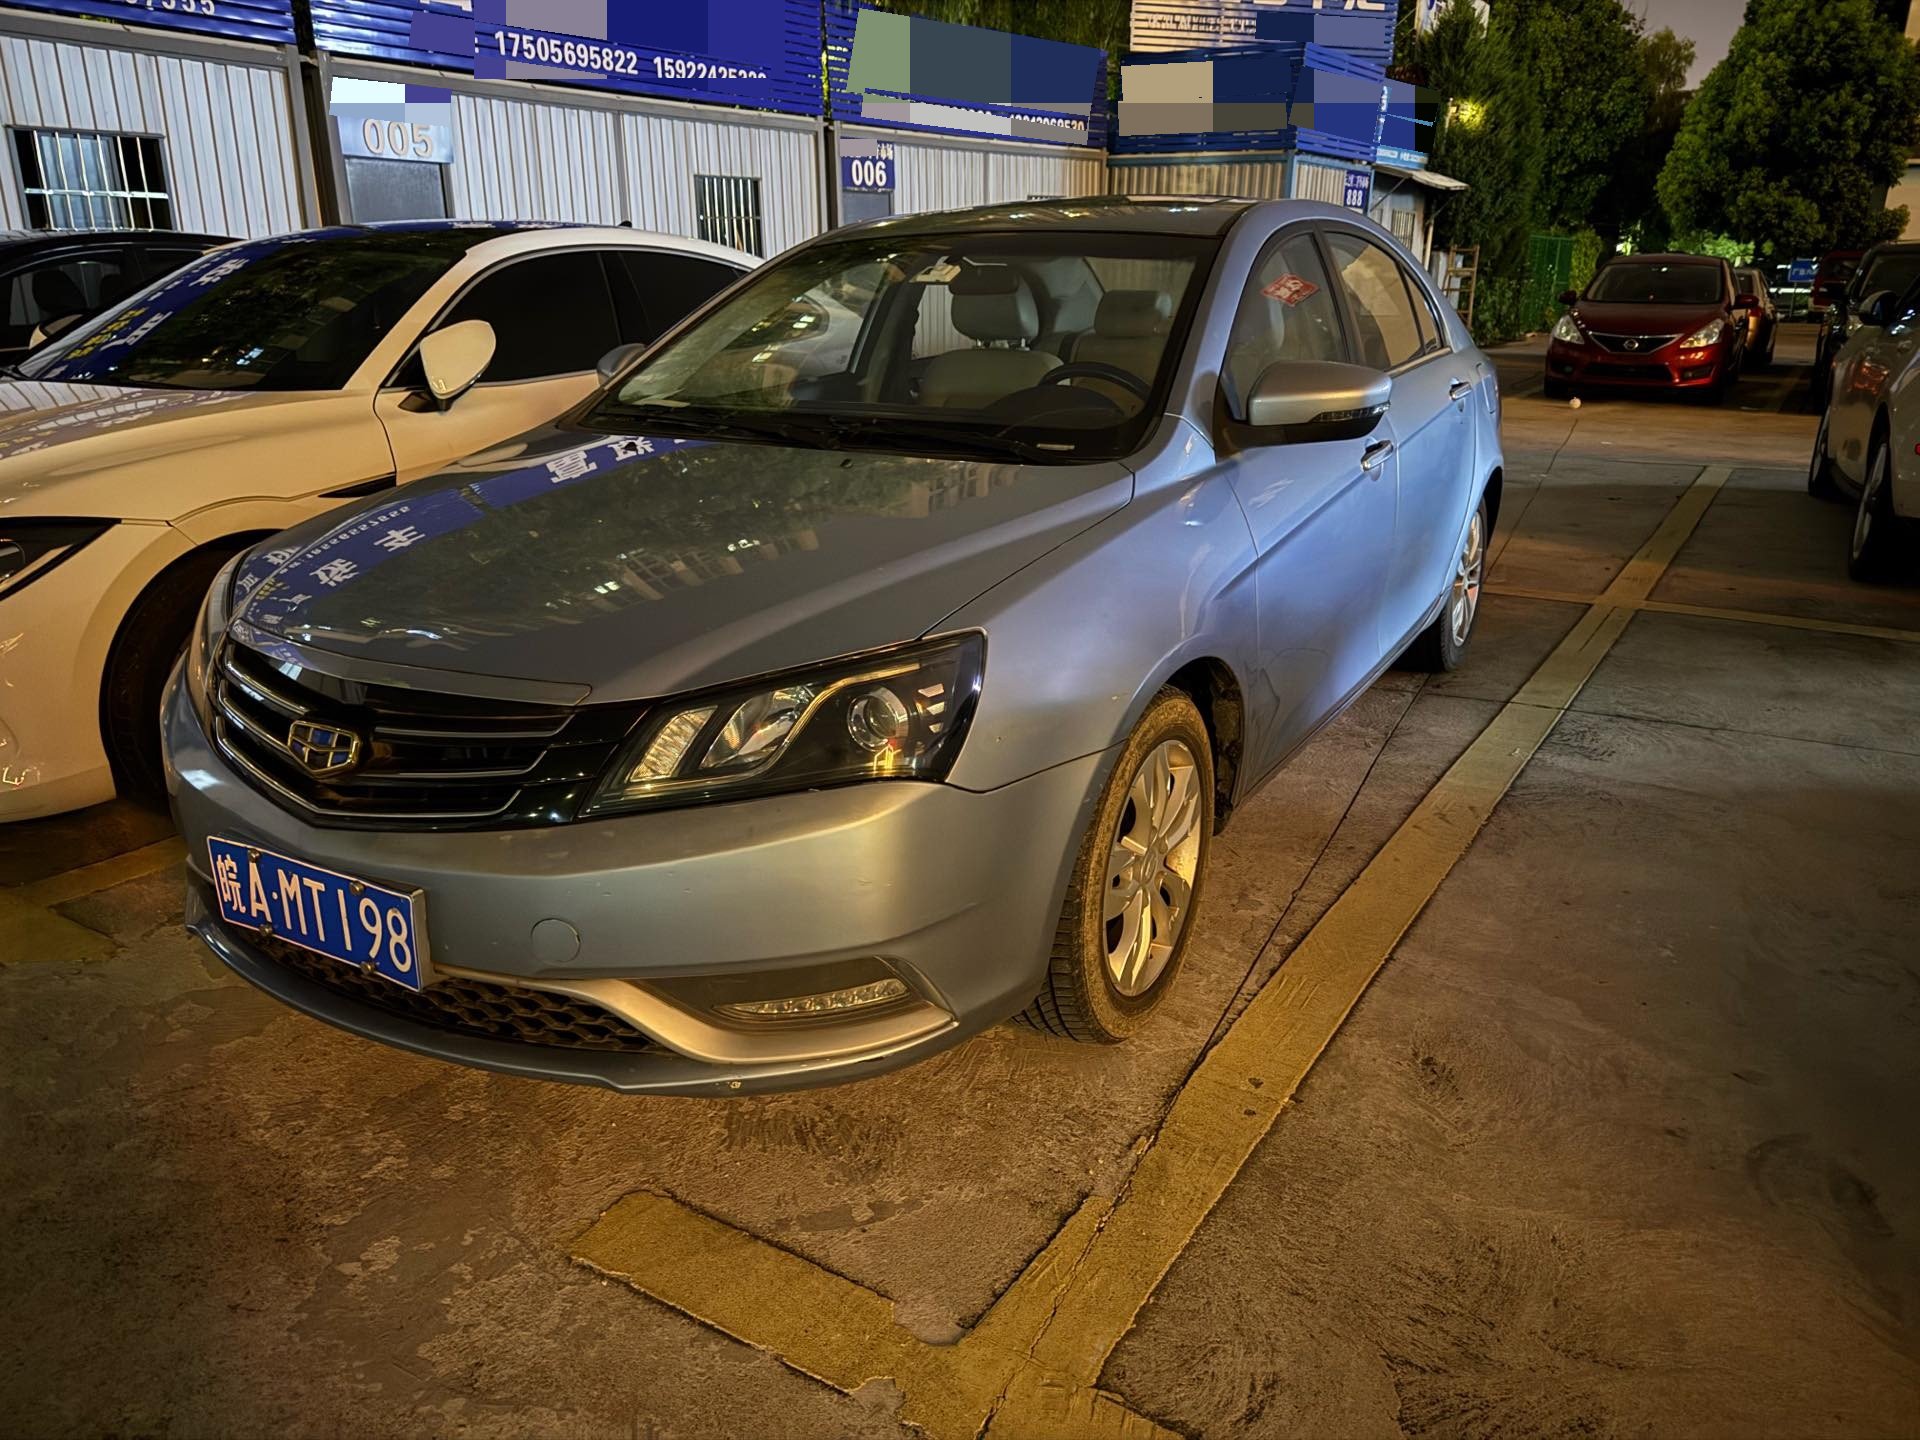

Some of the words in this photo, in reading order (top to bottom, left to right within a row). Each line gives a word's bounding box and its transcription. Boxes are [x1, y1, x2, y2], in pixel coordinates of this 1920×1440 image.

[495, 30, 639, 75] 17505695822
[362, 118, 433, 158] 005
[851, 159, 887, 187] 006
[1346, 189, 1363, 206] 888
[216, 854, 412, 973] 皖A·MT198
